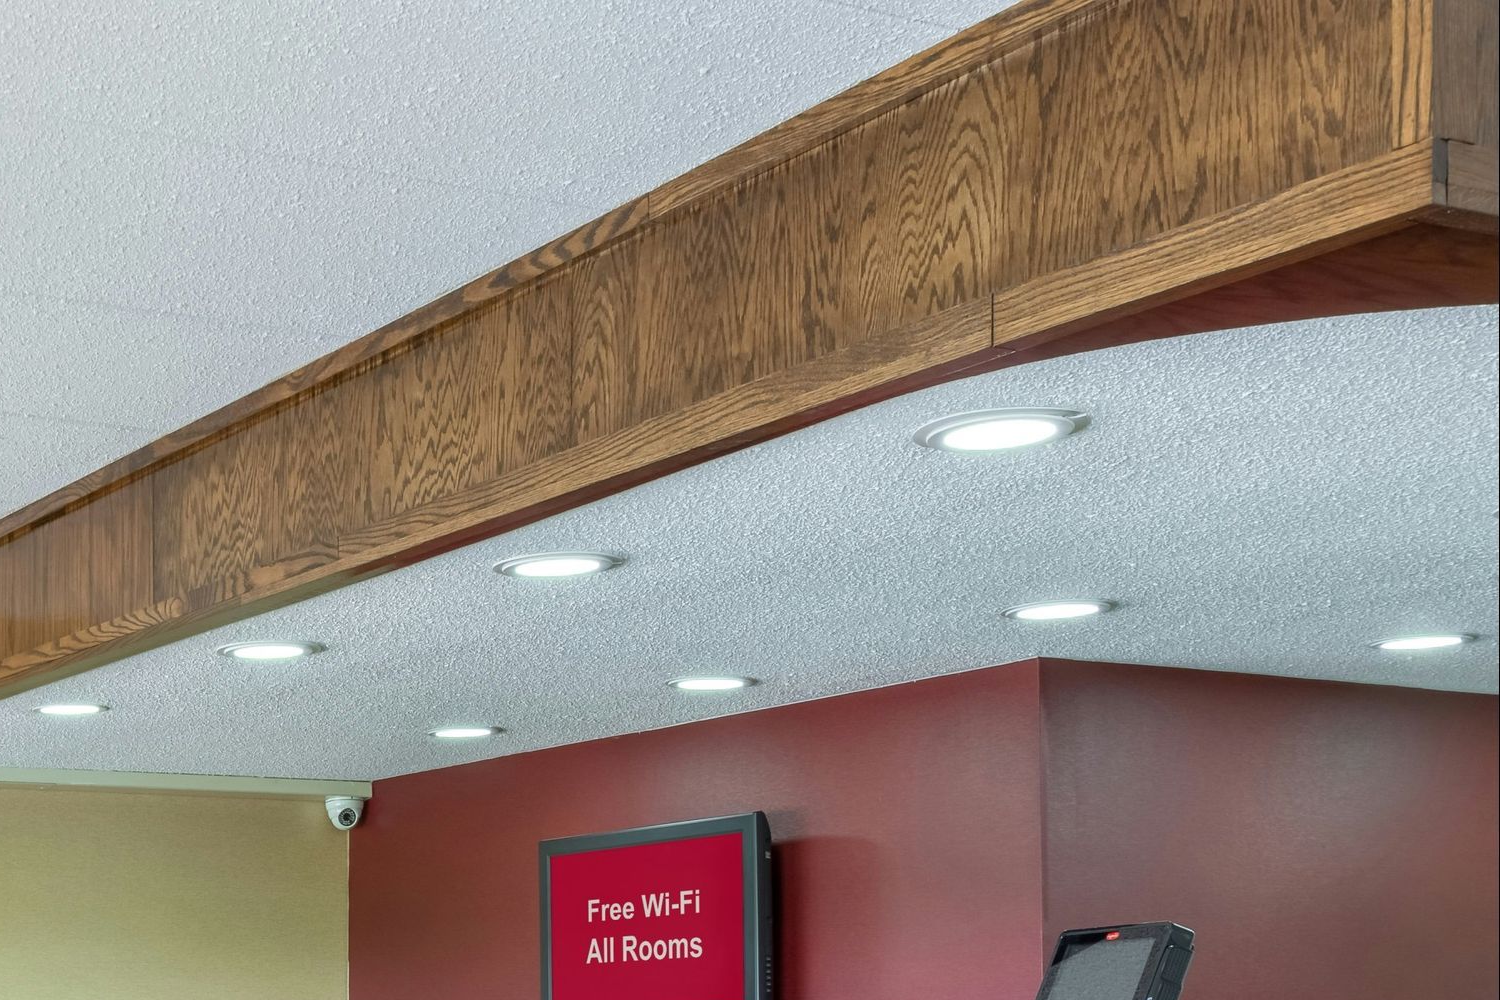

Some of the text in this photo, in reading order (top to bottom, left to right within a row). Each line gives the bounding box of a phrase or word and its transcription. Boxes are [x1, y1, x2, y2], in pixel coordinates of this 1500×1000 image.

[587, 889, 700, 923] Free Wi-Fi
[586, 935, 703, 965] All Rooms
